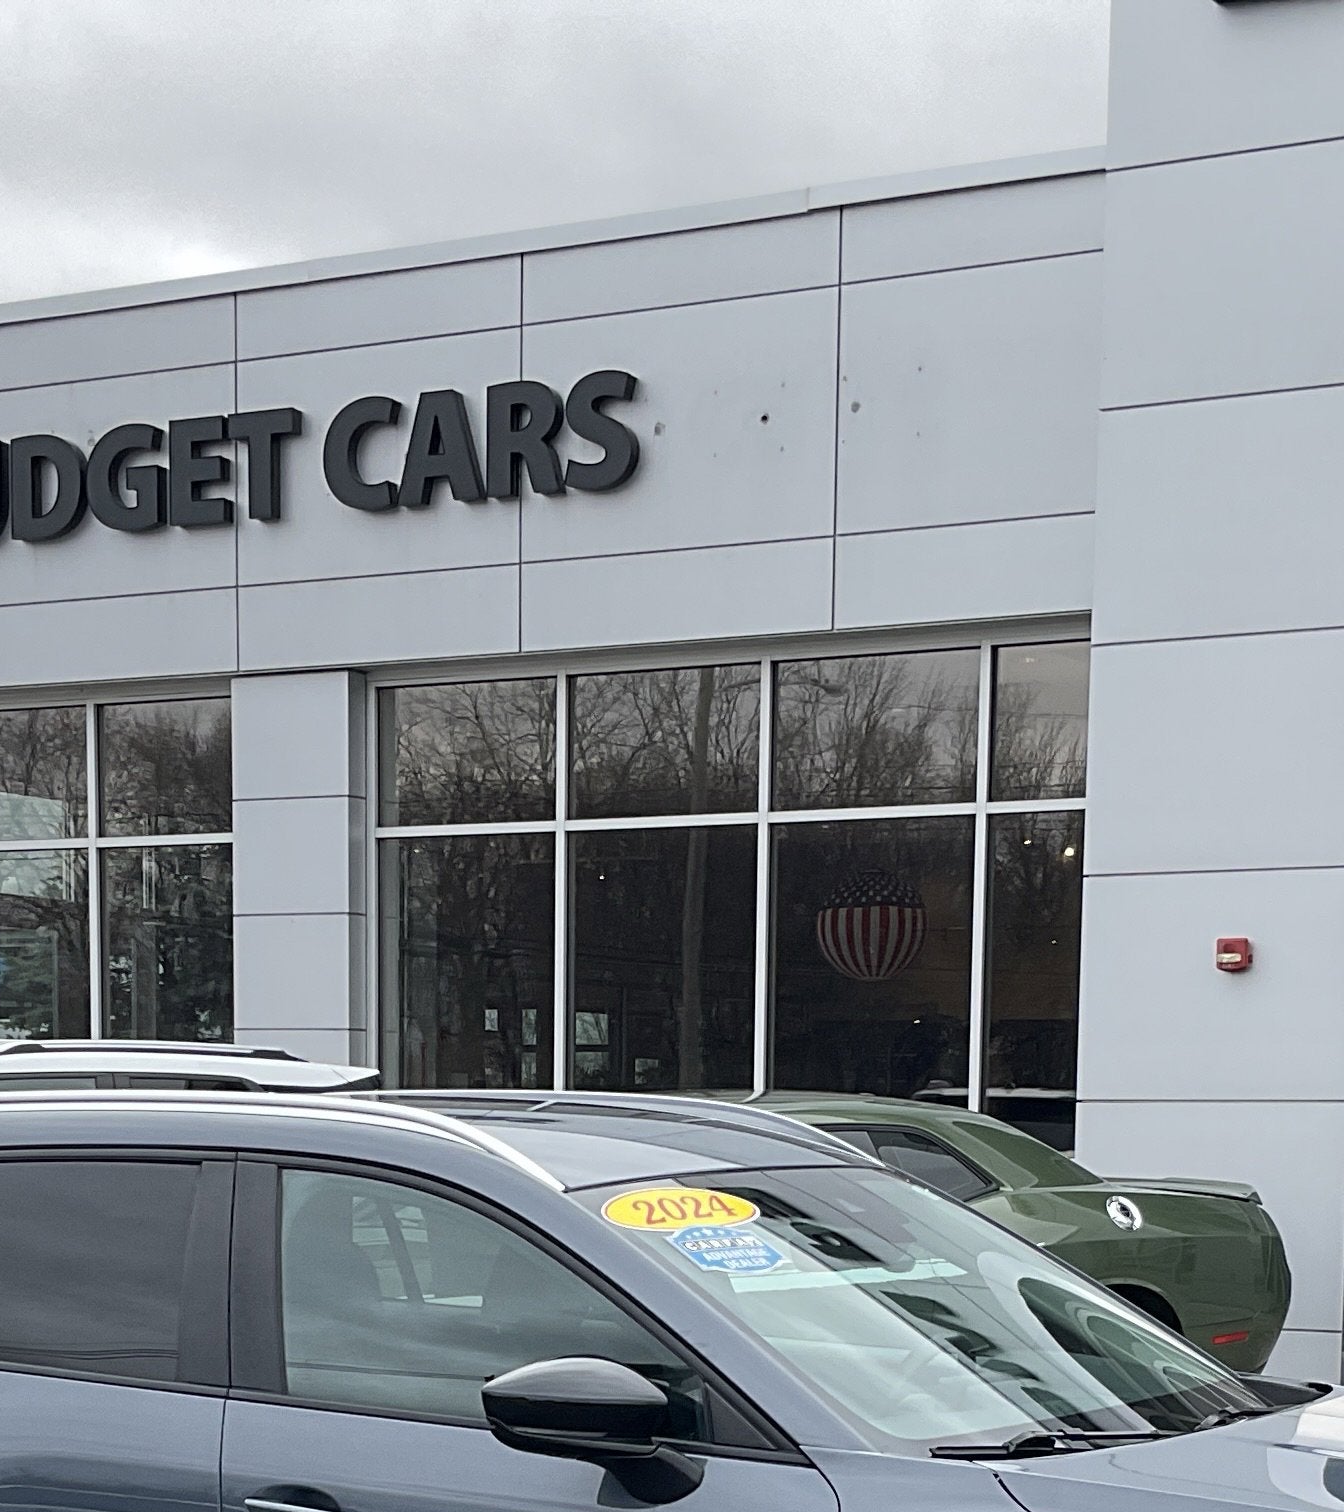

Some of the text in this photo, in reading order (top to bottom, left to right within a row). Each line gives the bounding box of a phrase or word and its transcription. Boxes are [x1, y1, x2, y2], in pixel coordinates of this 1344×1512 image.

[323, 369, 640, 511] CARS
[632, 1195, 737, 1225] 2024
[702, 1248, 771, 1261] ADVANTAGE
[723, 1257, 771, 1269] DEALER
